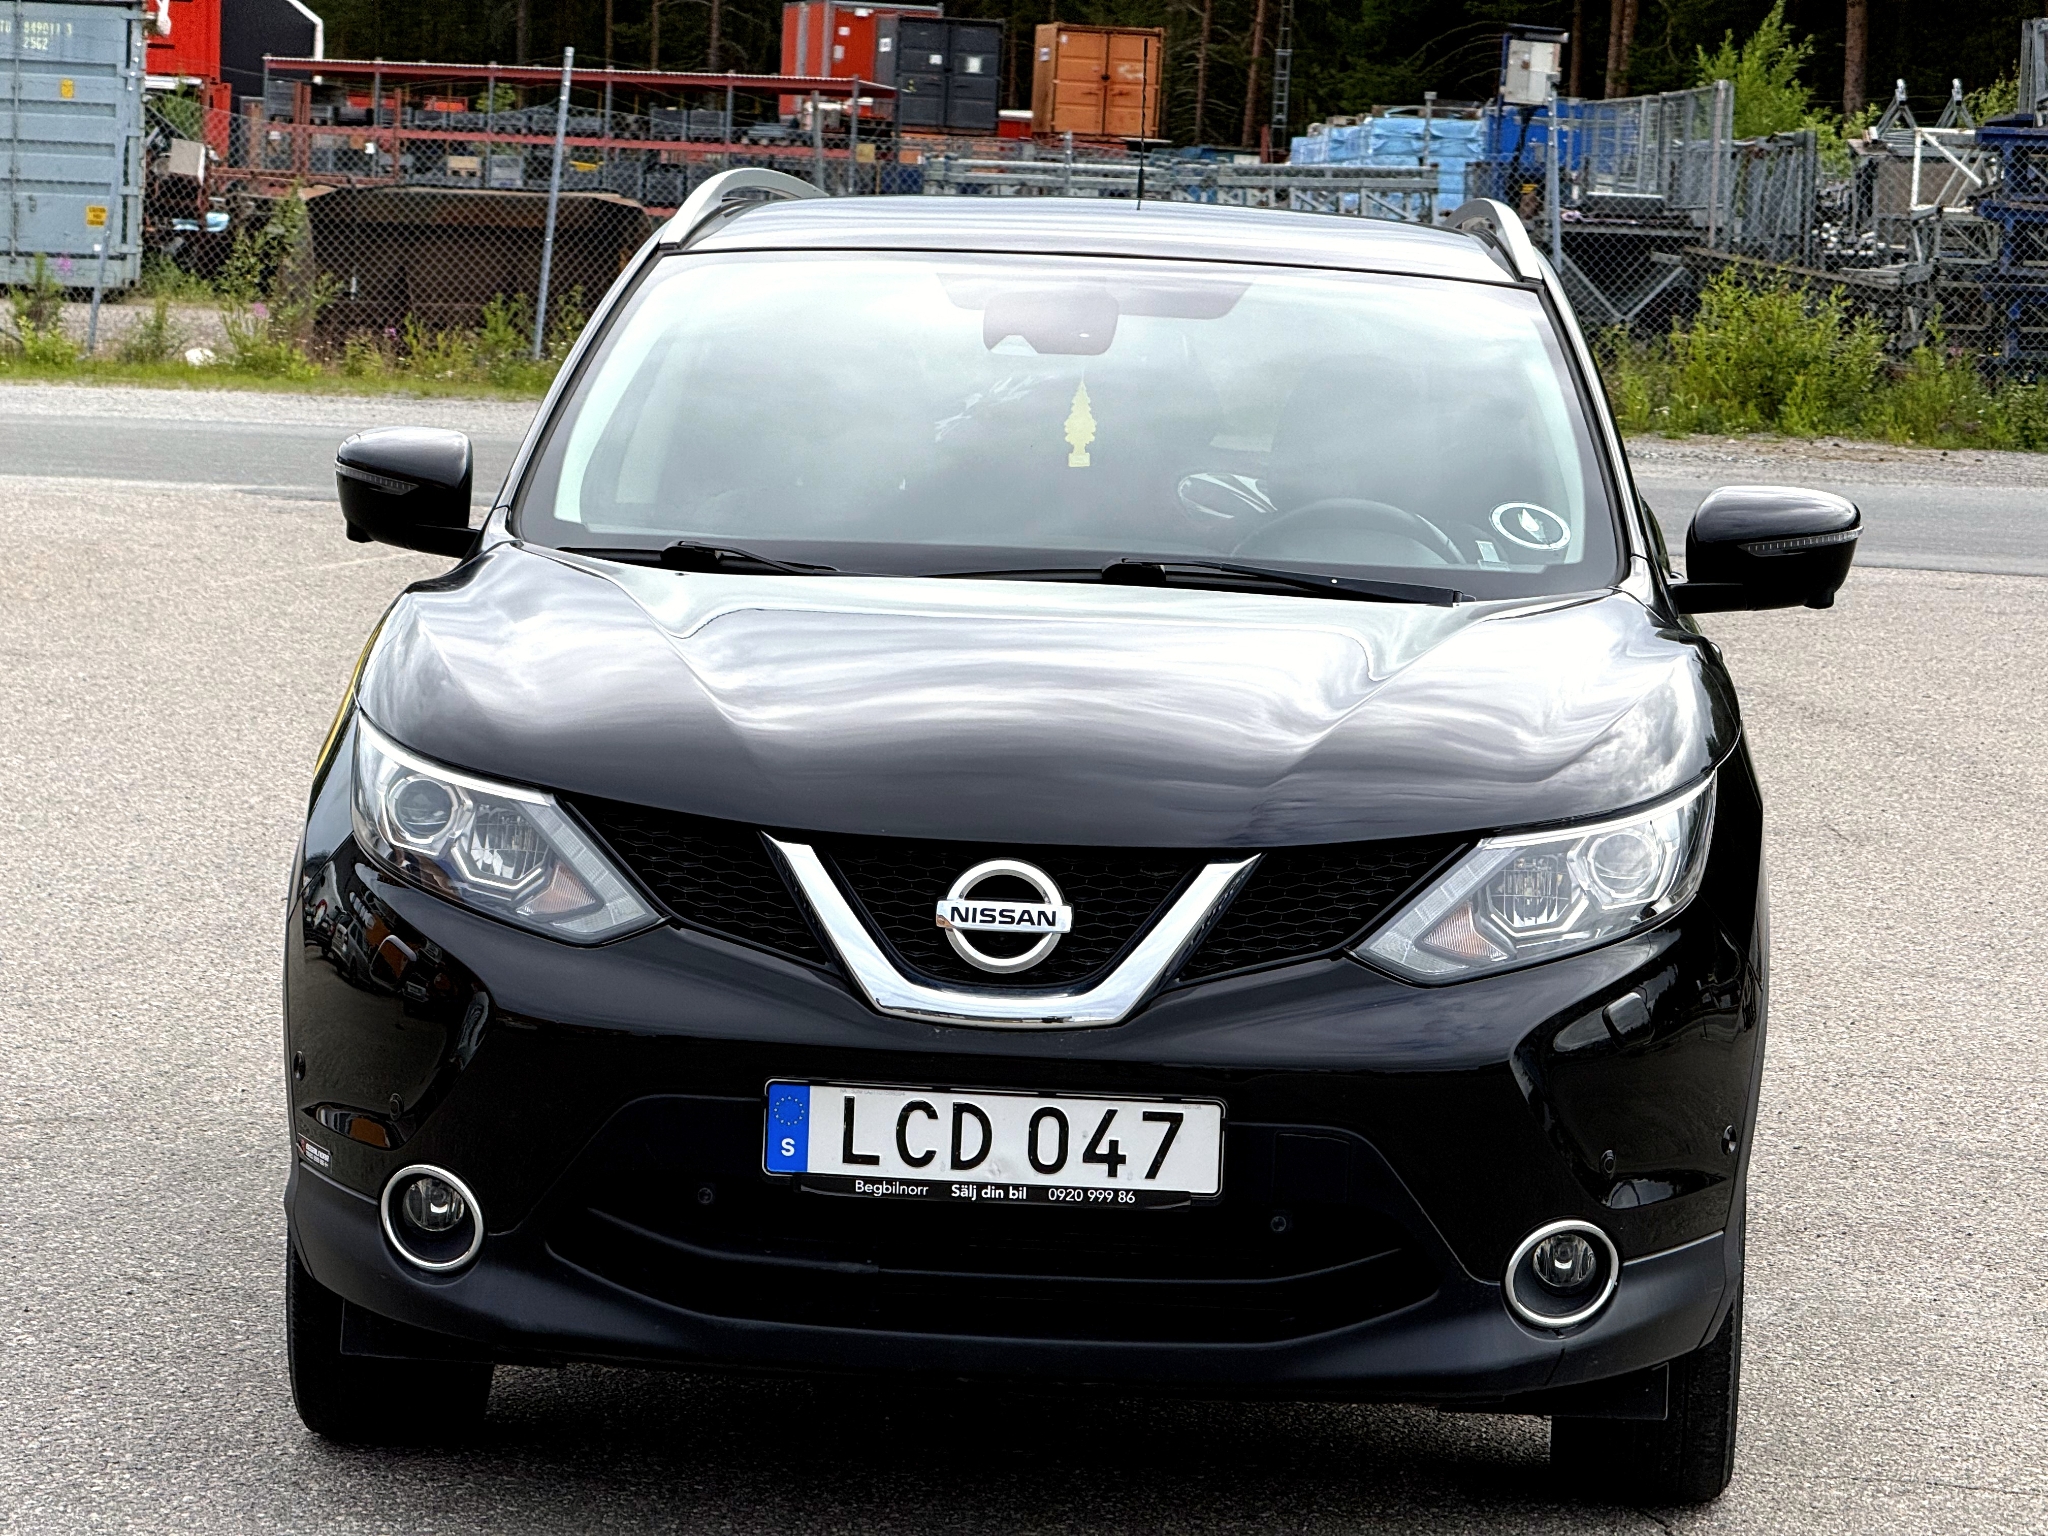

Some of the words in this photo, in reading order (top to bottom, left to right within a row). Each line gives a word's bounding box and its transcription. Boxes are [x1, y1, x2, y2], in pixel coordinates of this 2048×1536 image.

[950, 906, 1057, 926] NISSAN
[780, 1138, 796, 1157] S
[842, 1095, 993, 1171] LCD
[1027, 1106, 1184, 1180] 047
[855, 1180, 929, 1197] Begbilnorr
[951, 1184, 978, 1202] Sälj
[981, 1185, 1005, 1199] din
[1008, 1186, 1028, 1200] bil
[1048, 1188, 1083, 1202] 0920
[1087, 1190, 1113, 1203] 999
[1117, 1191, 1136, 1204] 86
